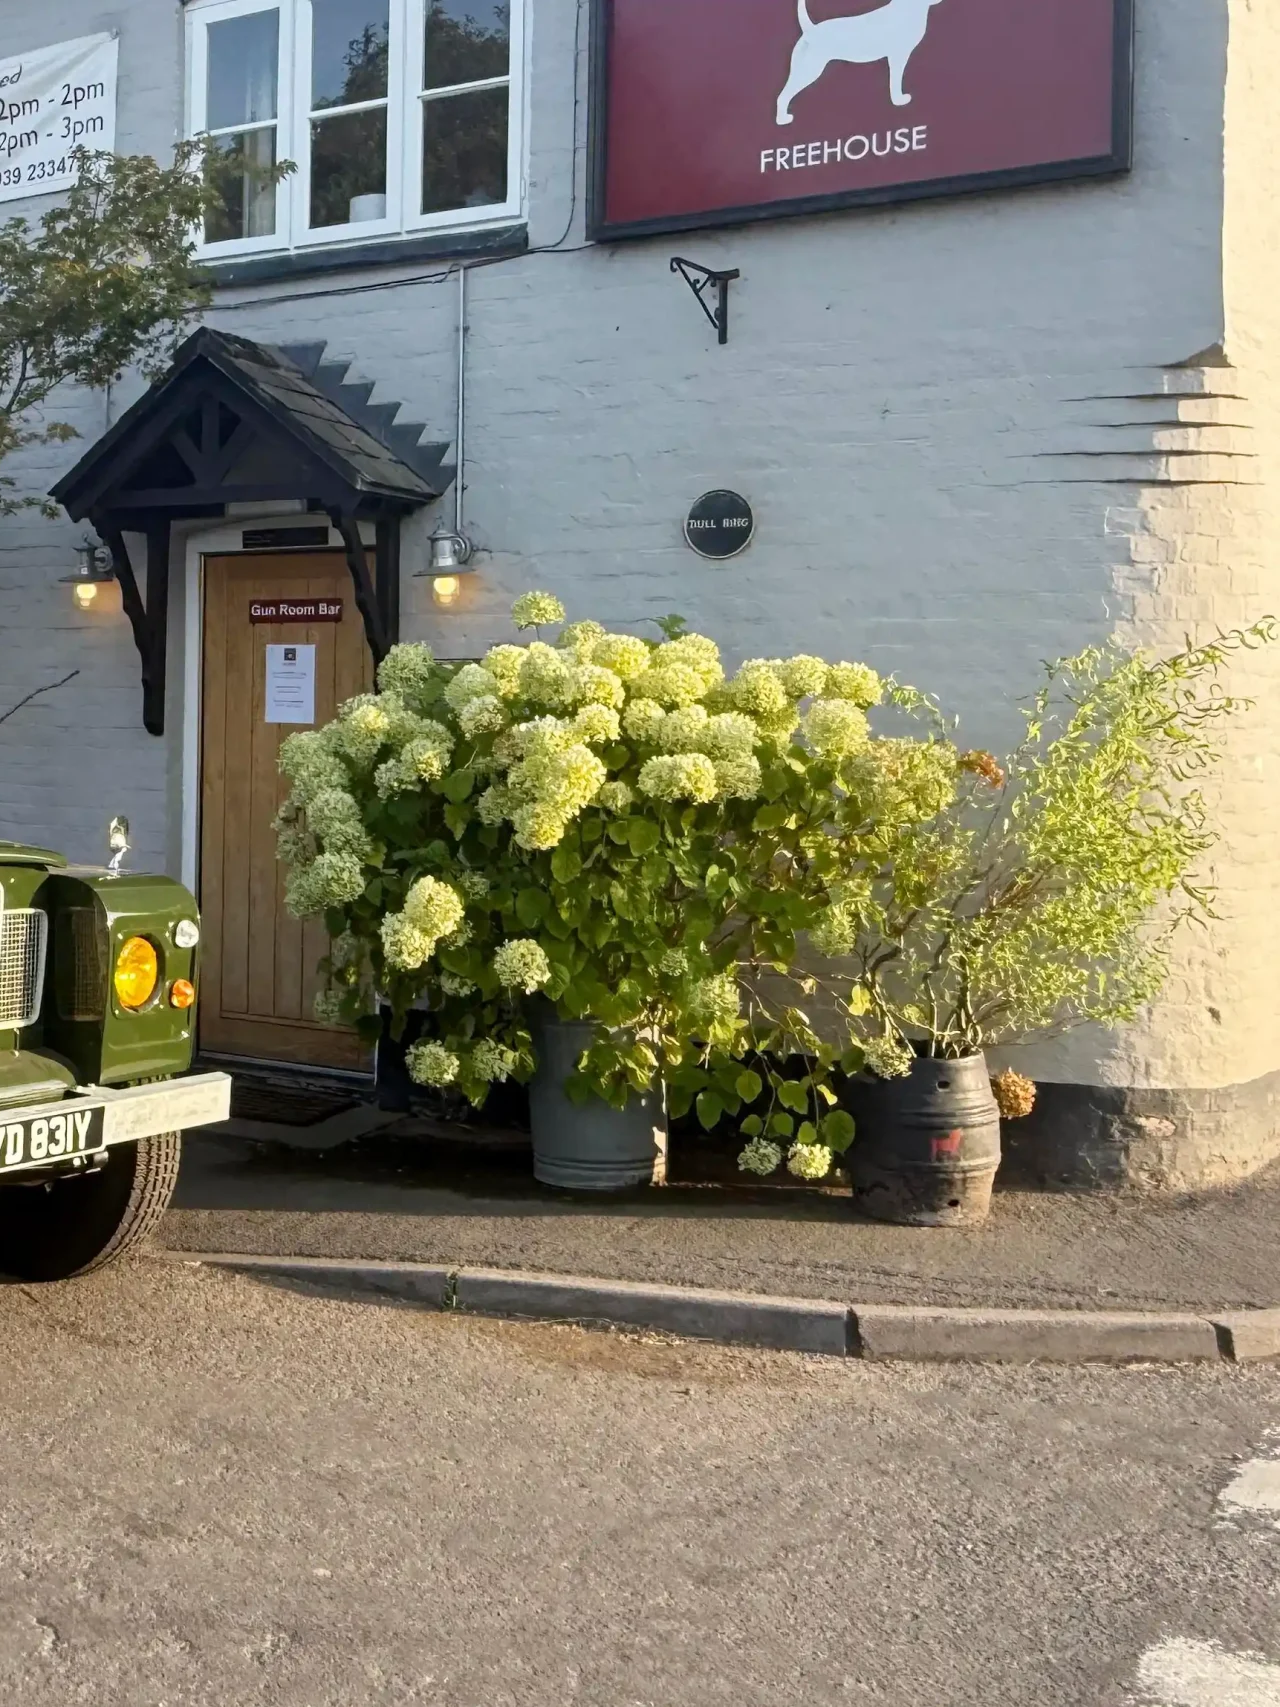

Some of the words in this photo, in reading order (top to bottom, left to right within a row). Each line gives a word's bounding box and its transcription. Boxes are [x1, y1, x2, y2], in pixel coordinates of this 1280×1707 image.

[61, 82, 104, 110] 2pm
[61, 115, 104, 142] 3pm
[760, 125, 928, 174] FREEHOUSE
[27, 155, 76, 182] 23347
[251, 604, 276, 616] Gun
[279, 604, 315, 616] Room
[319, 603, 341, 615] Bar
[30, 1110, 92, 1159] 831Y
